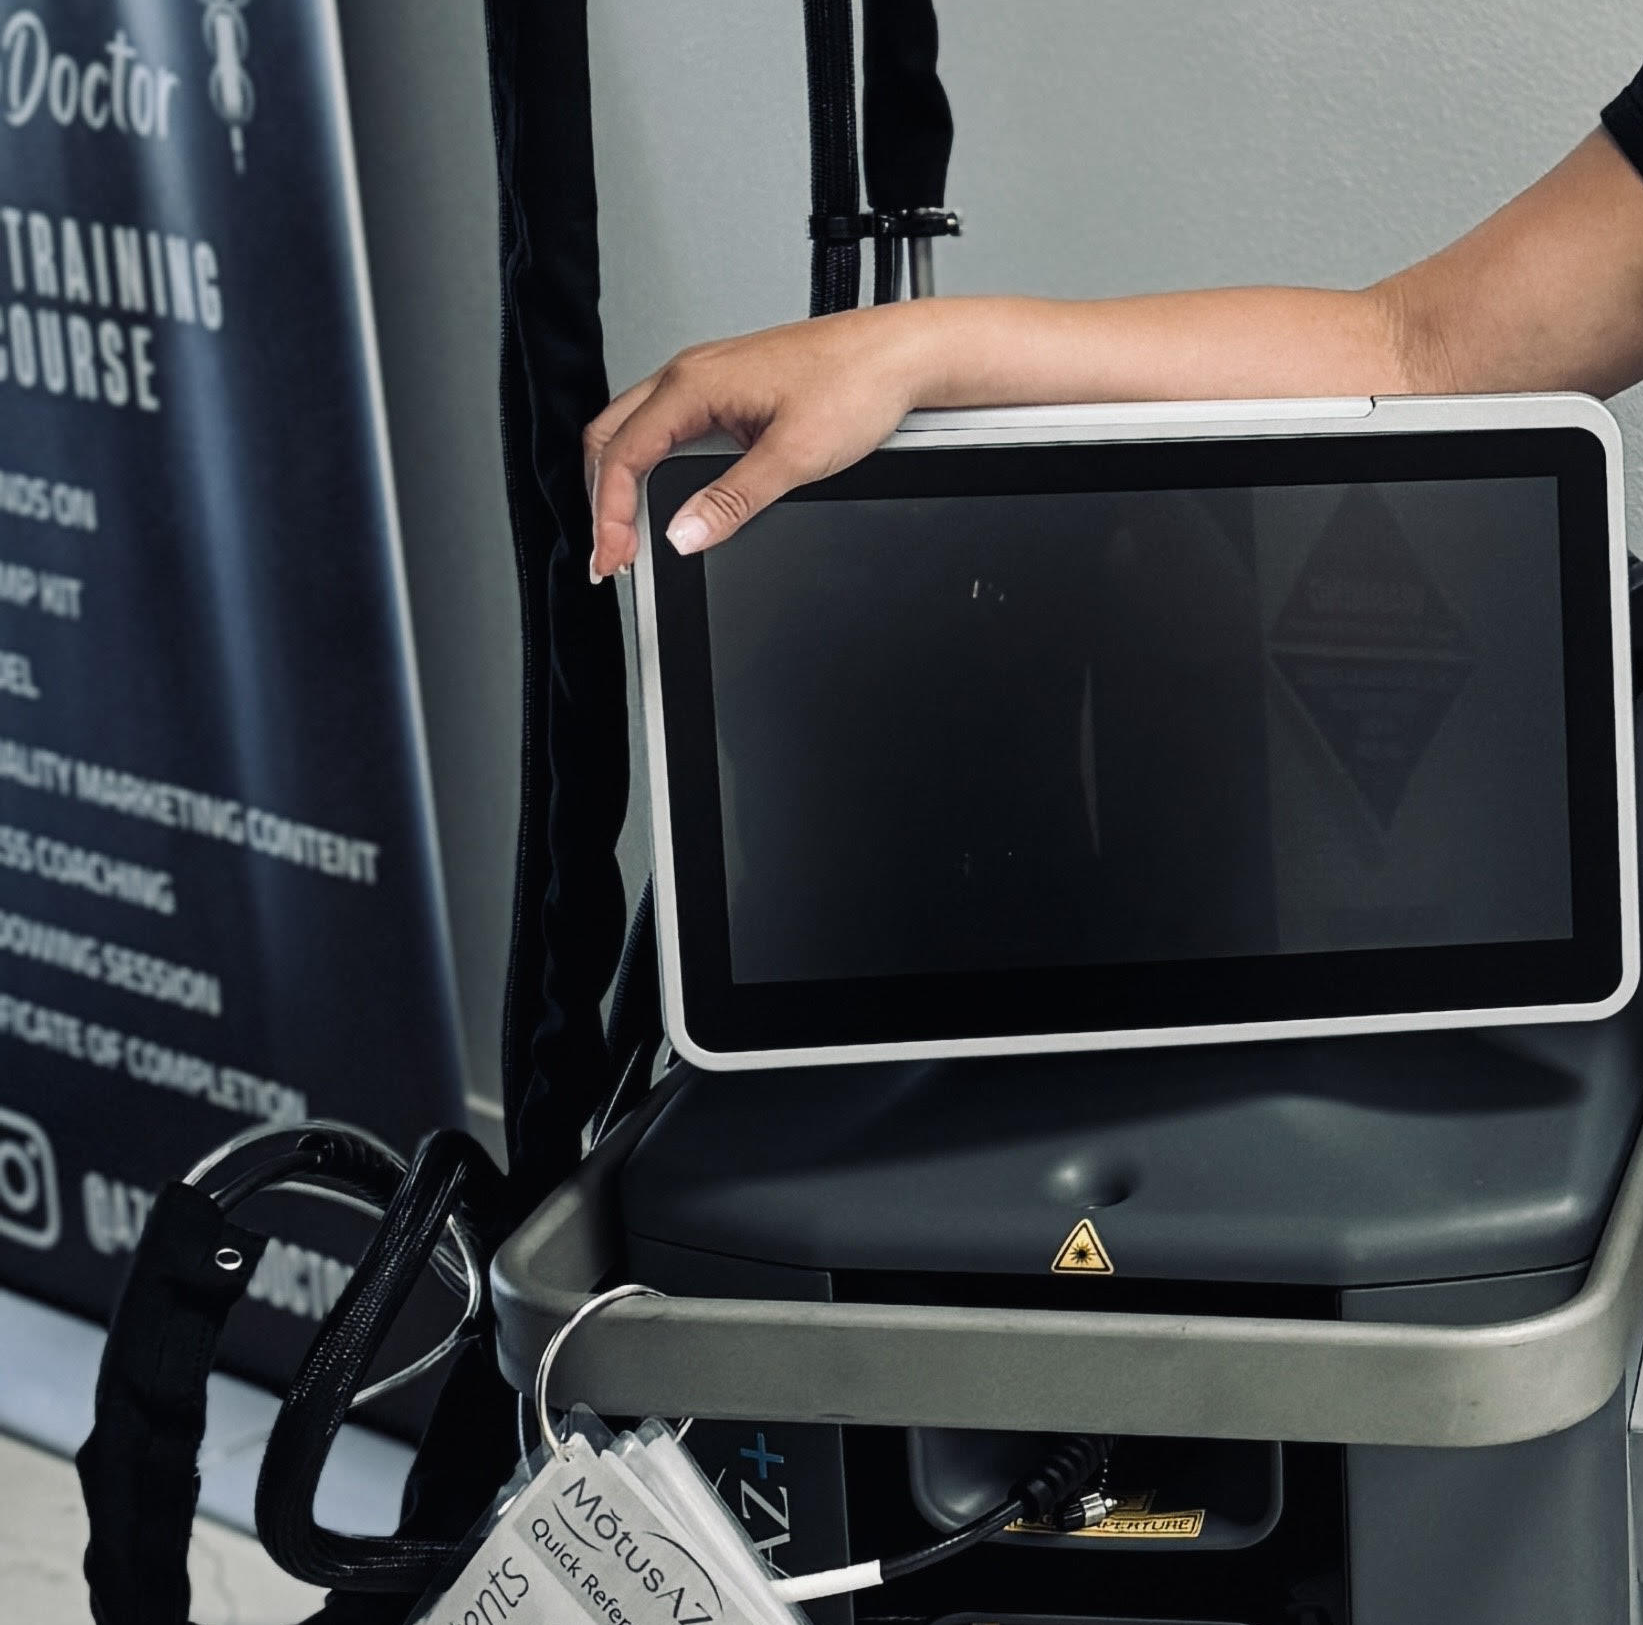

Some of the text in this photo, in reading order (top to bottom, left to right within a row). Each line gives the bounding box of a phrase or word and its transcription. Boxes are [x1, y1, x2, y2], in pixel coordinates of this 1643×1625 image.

[3, 11, 180, 141] Doctor
[0, 206, 223, 331] TRAINING
[75, 760, 245, 846] MARKETING
[246, 804, 380, 885] CONTENT
[36, 835, 177, 915] COACHING
[101, 941, 222, 1018] SESSION
[125, 1035, 307, 1124] COMPLETION
[530, 1517, 582, 1582] Quick
